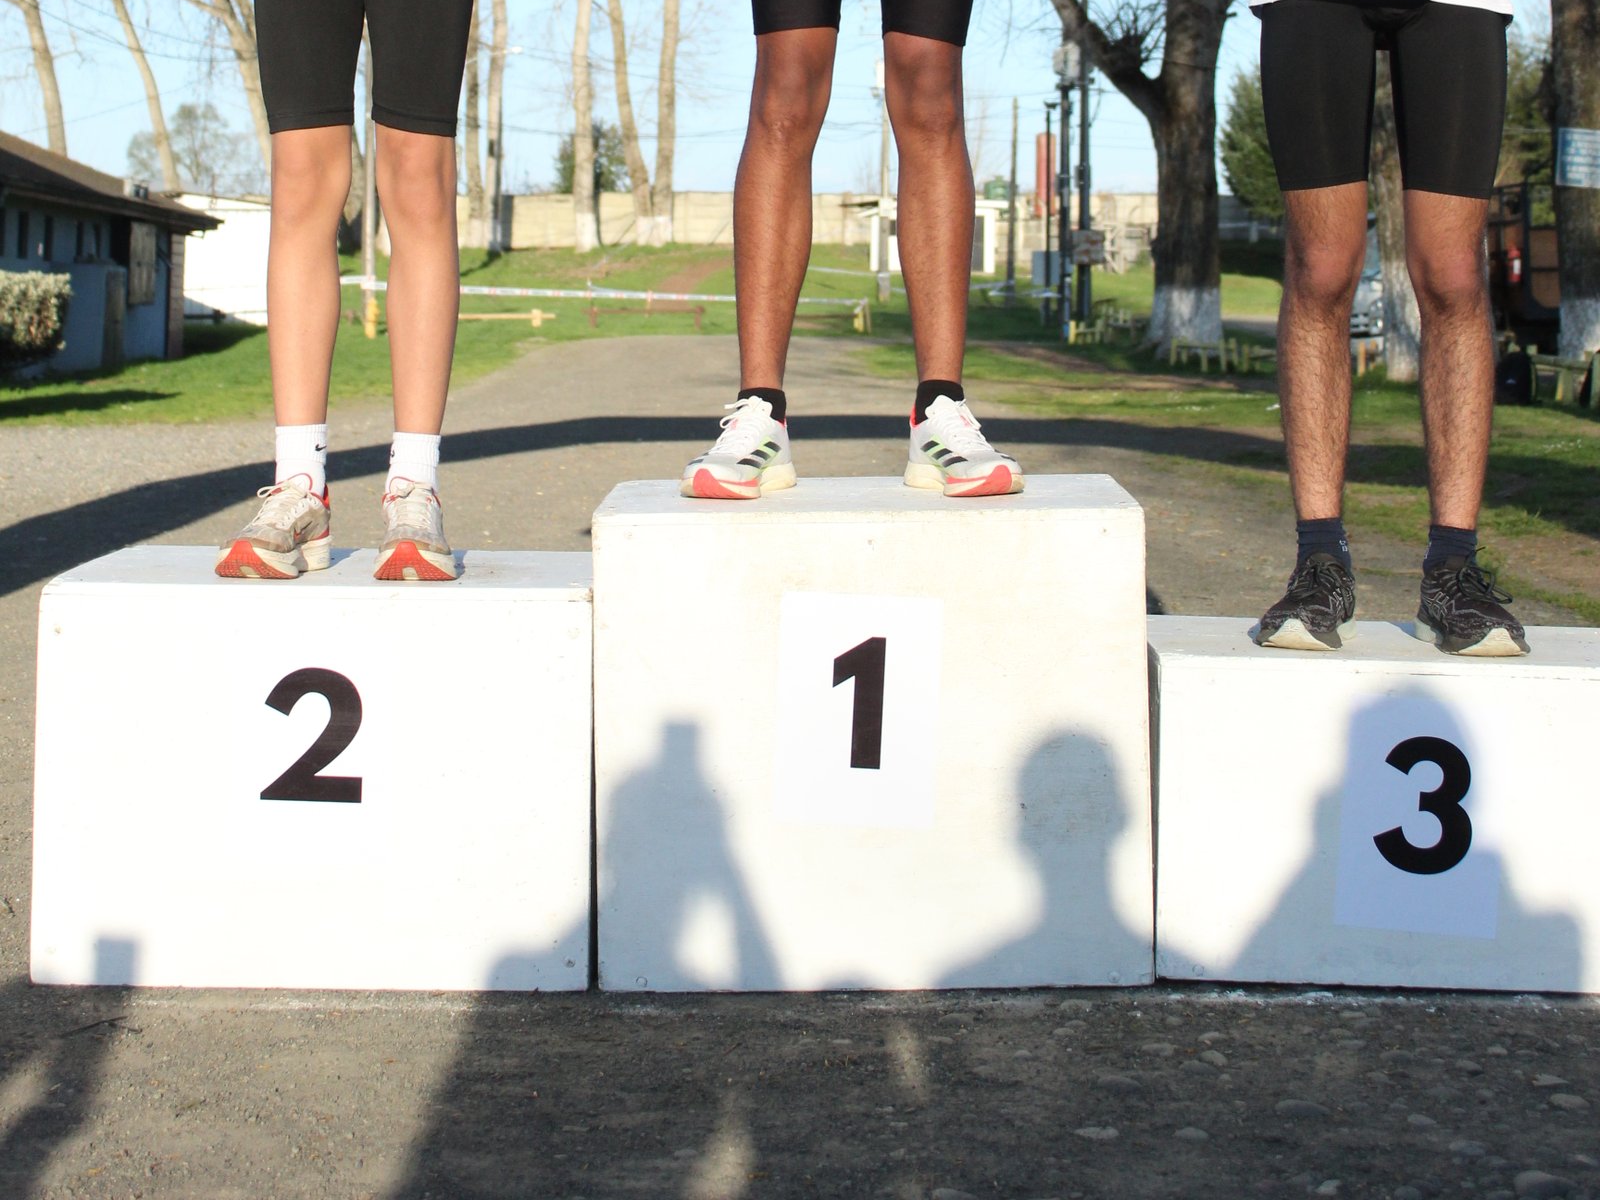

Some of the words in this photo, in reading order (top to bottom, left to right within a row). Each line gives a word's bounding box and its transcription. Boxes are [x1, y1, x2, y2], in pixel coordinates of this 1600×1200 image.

[261, 668, 362, 803] 2
[833, 638, 885, 770] 1
[1373, 736, 1473, 875] 3
